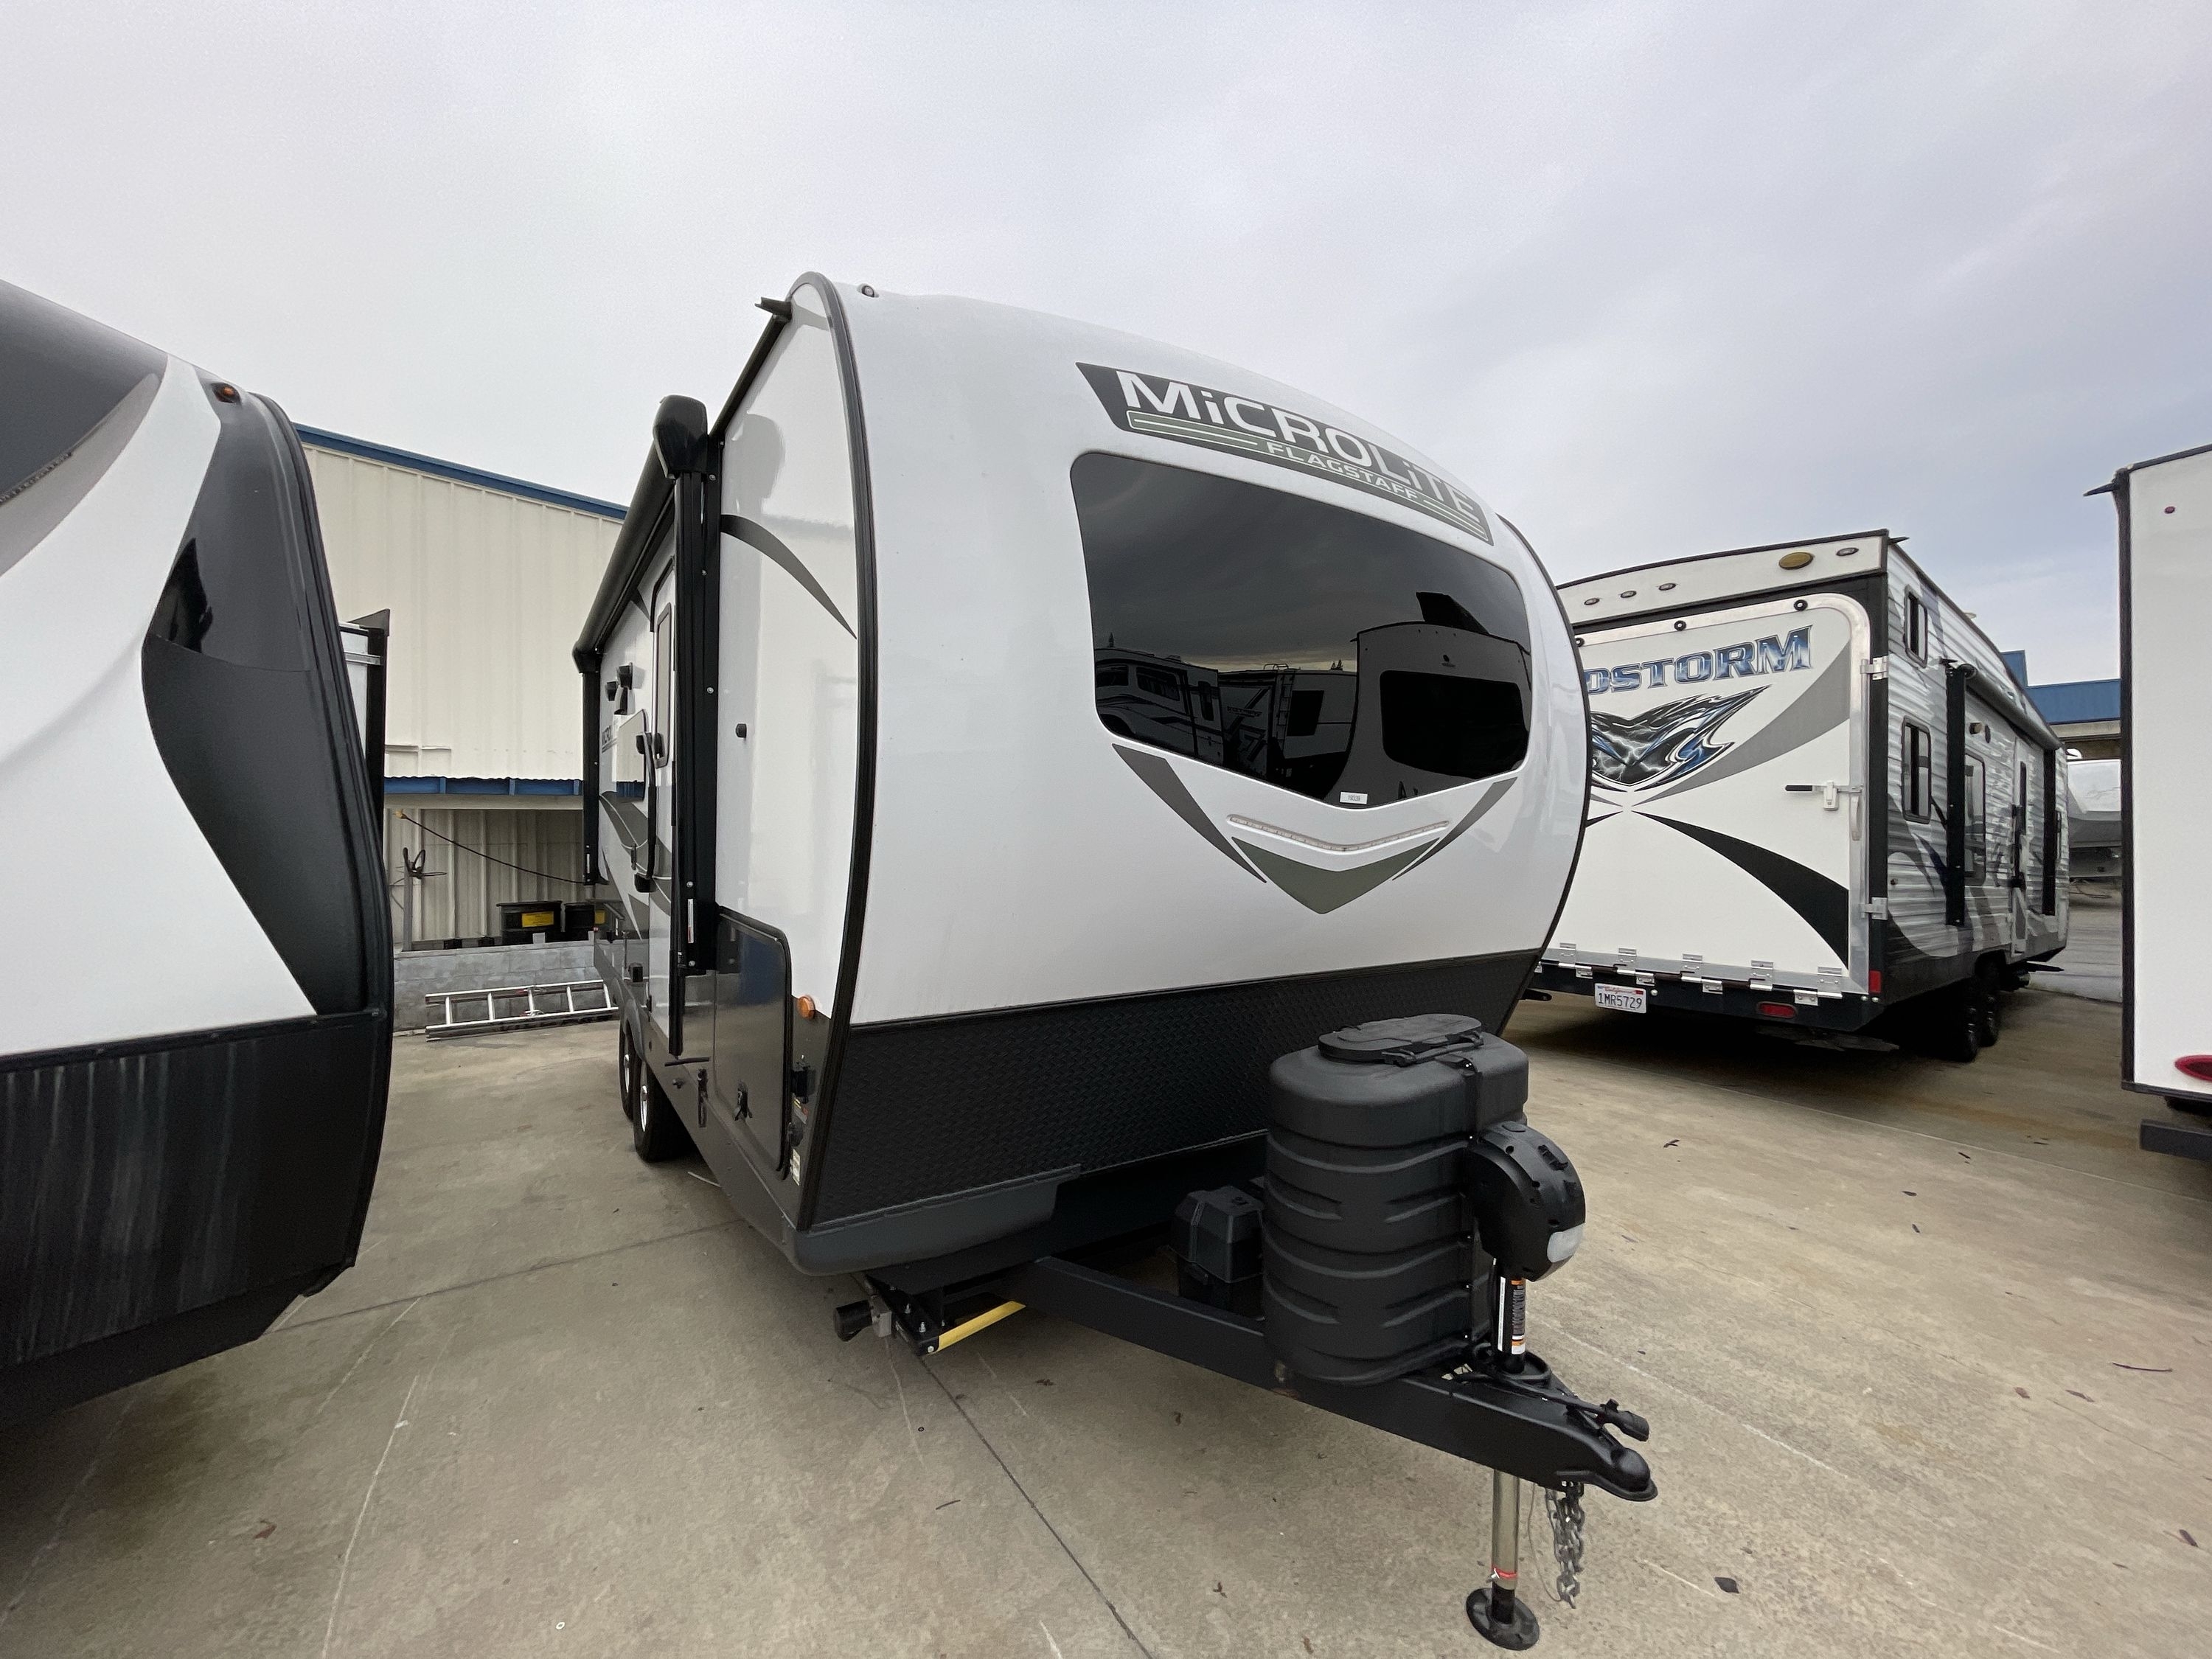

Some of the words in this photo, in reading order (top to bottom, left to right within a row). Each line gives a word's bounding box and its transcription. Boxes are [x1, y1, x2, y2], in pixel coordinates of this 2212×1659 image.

[1116, 370, 1481, 521] MiCROLiTE
[1265, 442, 1419, 500] FLAGSTAFF
[1584, 624, 1814, 695] DSTORM
[1598, 992, 1643, 1009] 1MR5729
